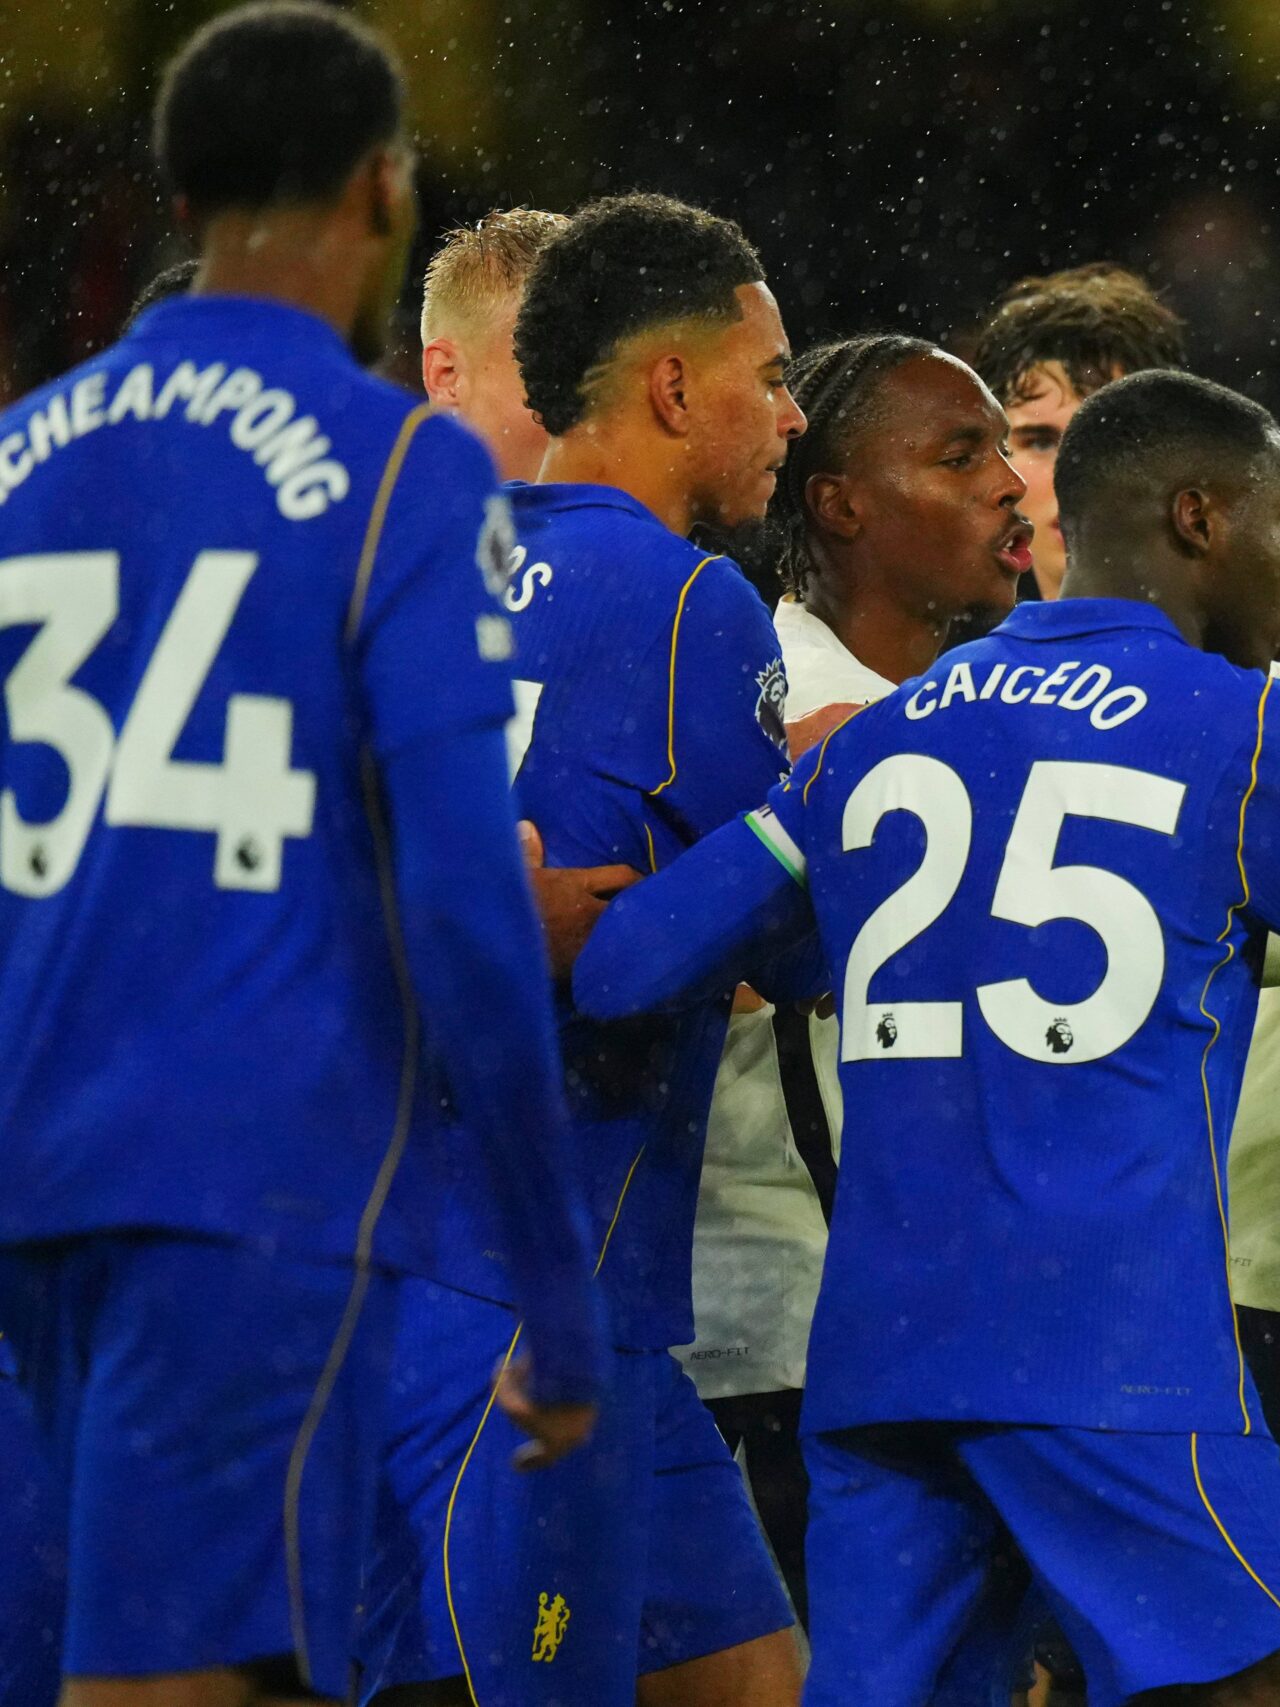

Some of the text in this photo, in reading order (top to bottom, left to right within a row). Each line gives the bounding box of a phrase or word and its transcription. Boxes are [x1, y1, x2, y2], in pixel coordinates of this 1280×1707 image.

[0, 360, 350, 521] CHEAMPONG
[0, 549, 317, 898] 34
[904, 661, 1147, 730] CAICEDO
[842, 753, 1187, 1064] 25
[690, 1346, 750, 1361] AERO-FIT
